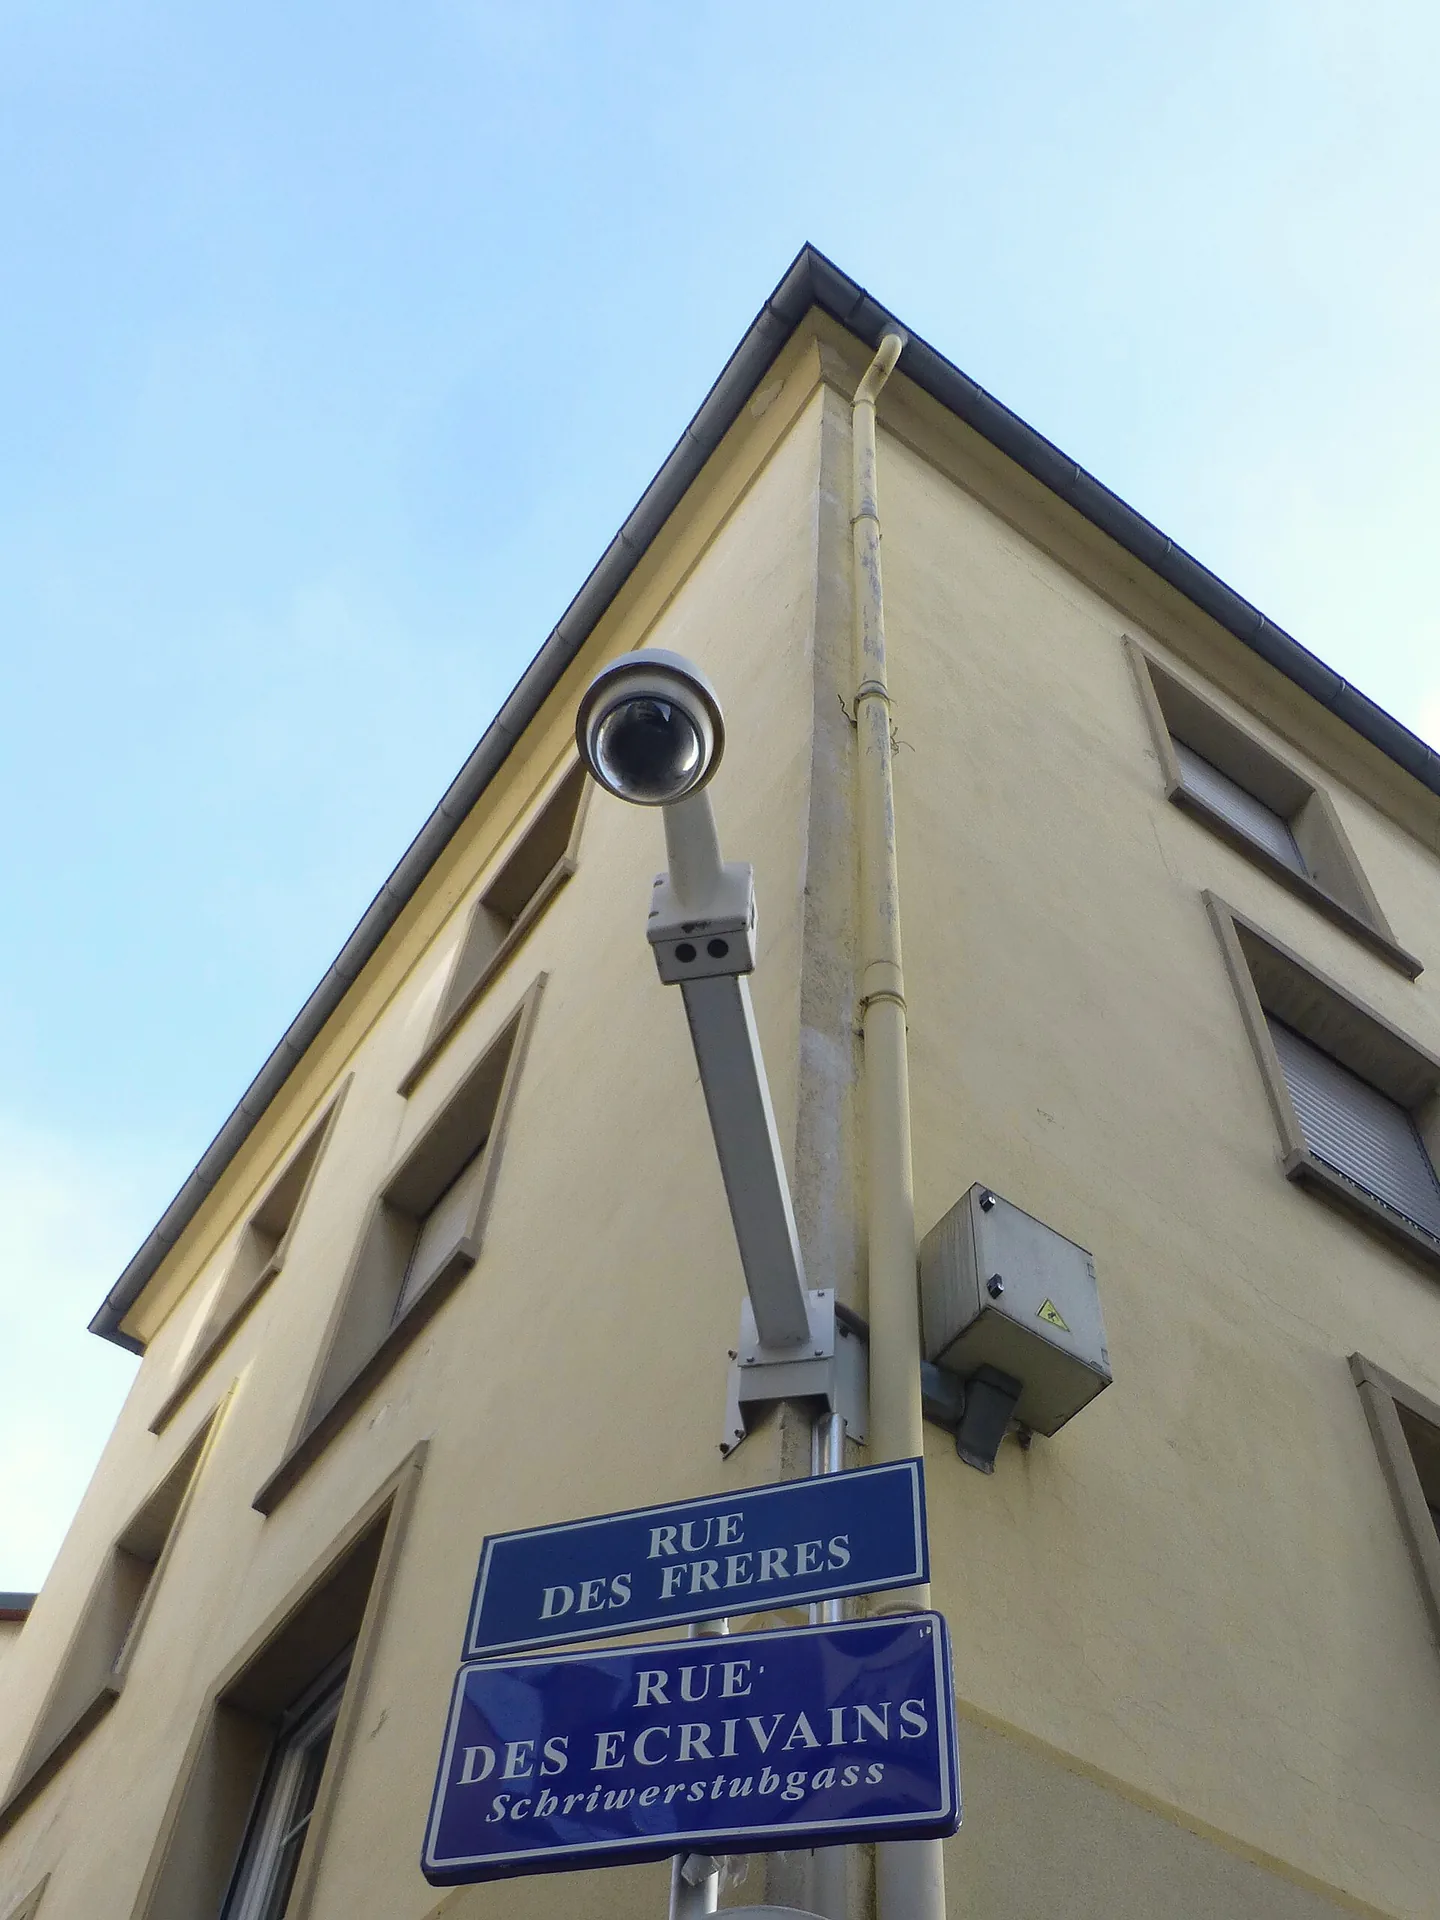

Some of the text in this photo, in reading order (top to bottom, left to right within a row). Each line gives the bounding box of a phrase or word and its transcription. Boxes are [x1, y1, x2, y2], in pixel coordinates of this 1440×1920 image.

[646, 1512, 745, 1559] RUE
[538, 1534, 850, 1620] DES FRERES
[632, 1660, 752, 1707] RUE
[456, 1698, 927, 1786] DES ECRIVAINS
[485, 1762, 885, 1822] Schriwerstubgass
